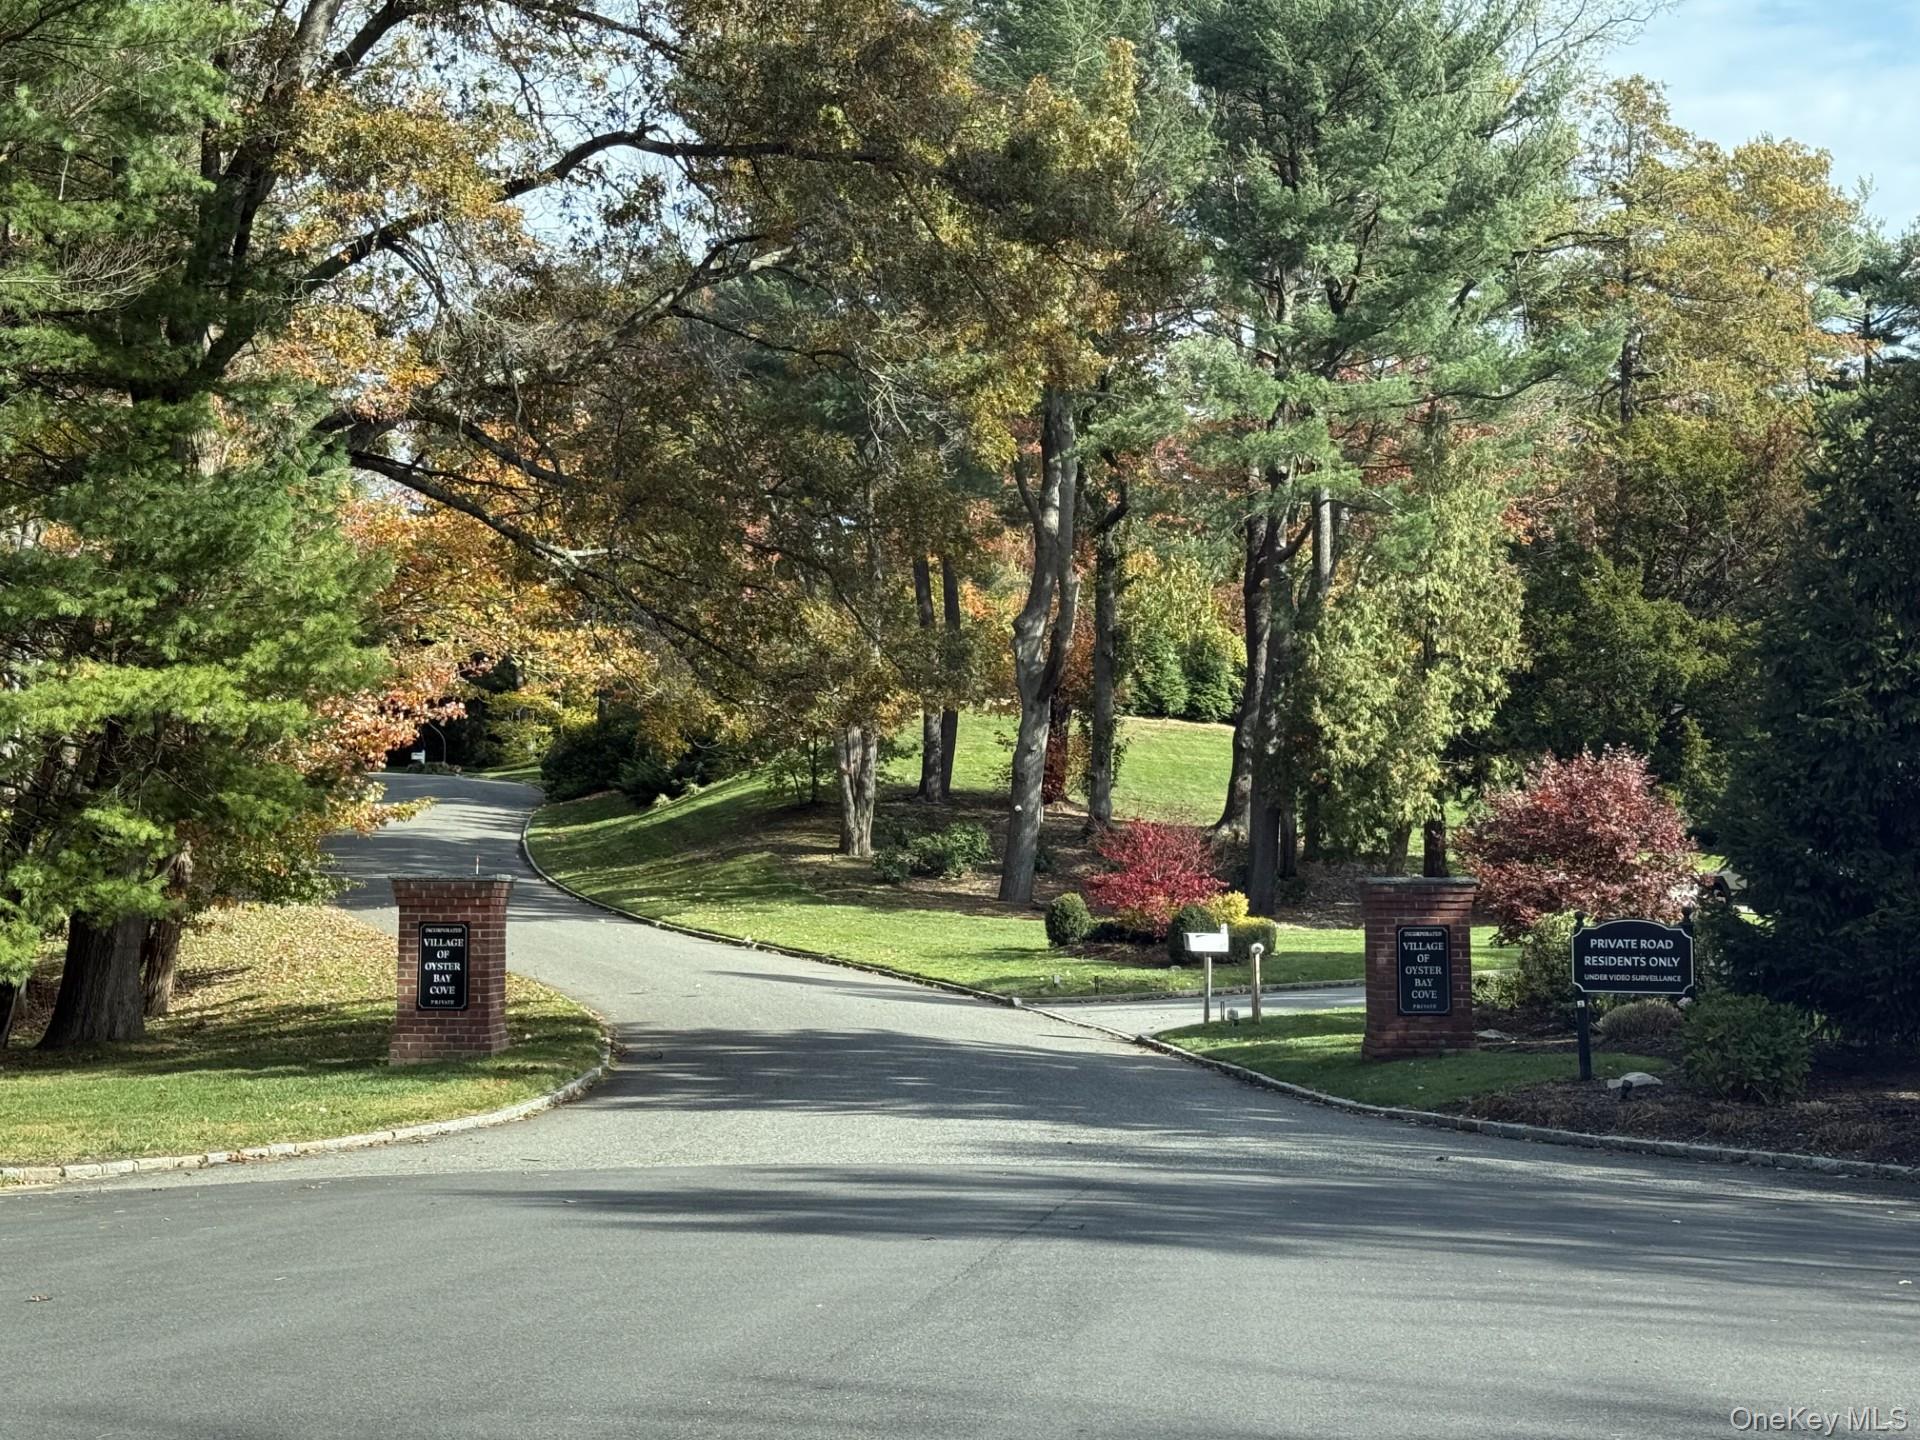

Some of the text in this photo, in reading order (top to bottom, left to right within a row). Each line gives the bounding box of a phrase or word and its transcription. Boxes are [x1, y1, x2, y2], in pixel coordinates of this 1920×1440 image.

[424, 938, 464, 947] VILLAGE
[1403, 942, 1444, 951] VILLAGE
[1590, 939, 1674, 949] PRIVATE ROAD
[437, 950, 450, 959] OF
[1417, 954, 1430, 963] OF
[1584, 956, 1680, 967] RESIDENTS ONLY
[425, 962, 461, 971] OYSTER
[1405, 966, 1442, 975] OYSTER
[433, 974, 451, 983] BAY
[1414, 979, 1433, 987] BAY
[429, 986, 455, 994] COVE
[1412, 990, 1437, 999] COVE
